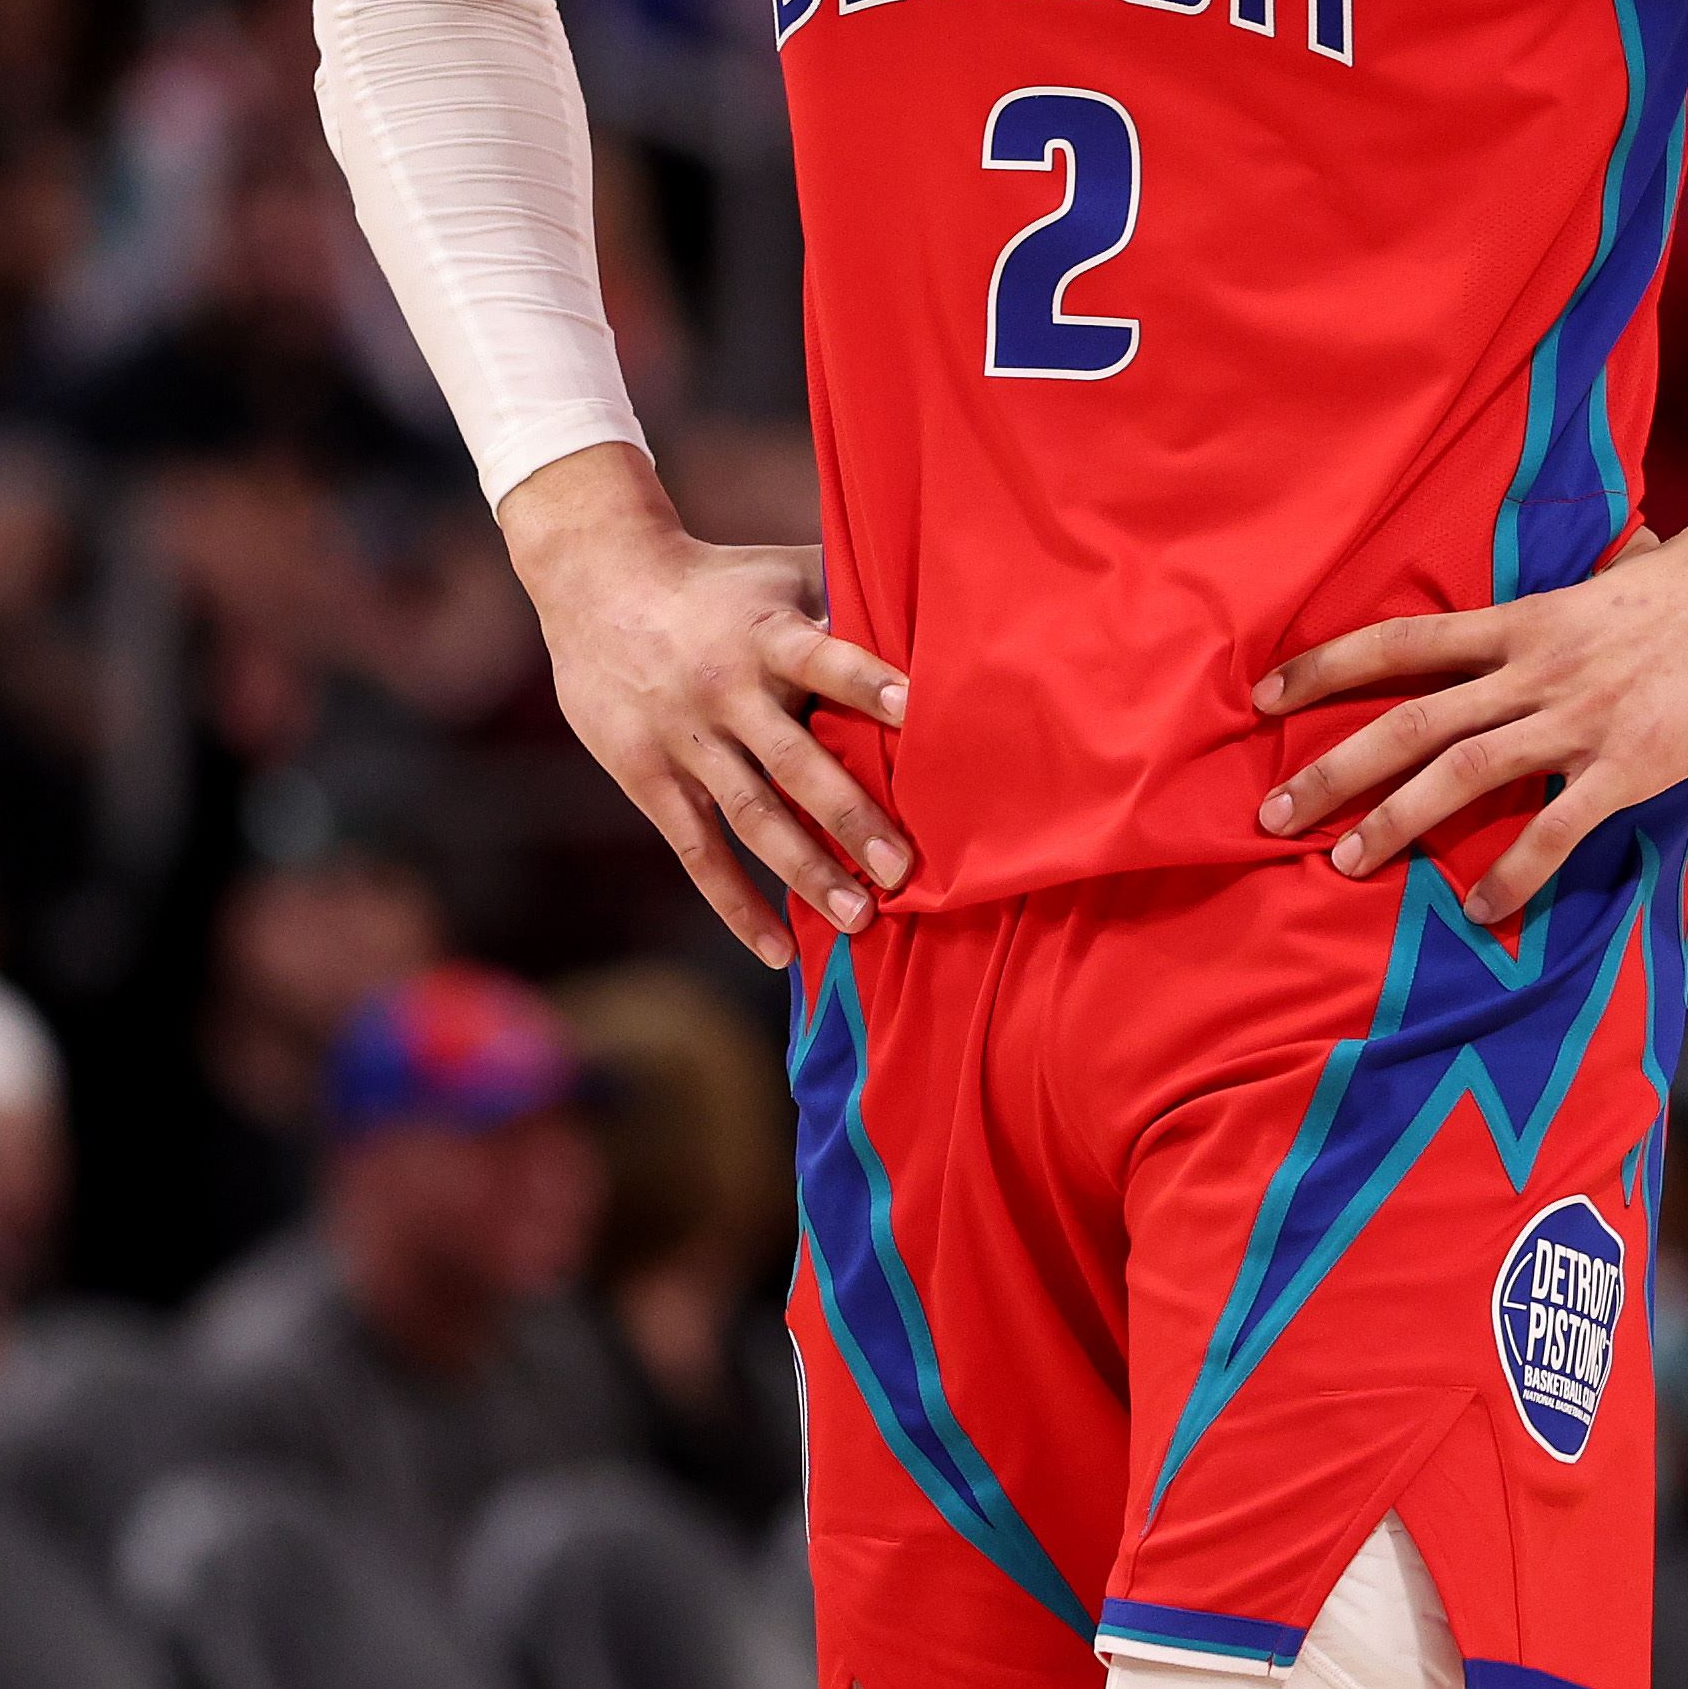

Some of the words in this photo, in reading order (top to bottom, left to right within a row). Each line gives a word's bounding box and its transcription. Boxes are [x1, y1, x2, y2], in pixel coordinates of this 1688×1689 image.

[981, 86, 1141, 381] 2
[1531, 1238, 1619, 1325] DETROIT
[1524, 1364, 1582, 1405] BASKETBALL
[1526, 1301, 1607, 1389] PISTONS
[1523, 1389, 1555, 1408] NATIONAL
